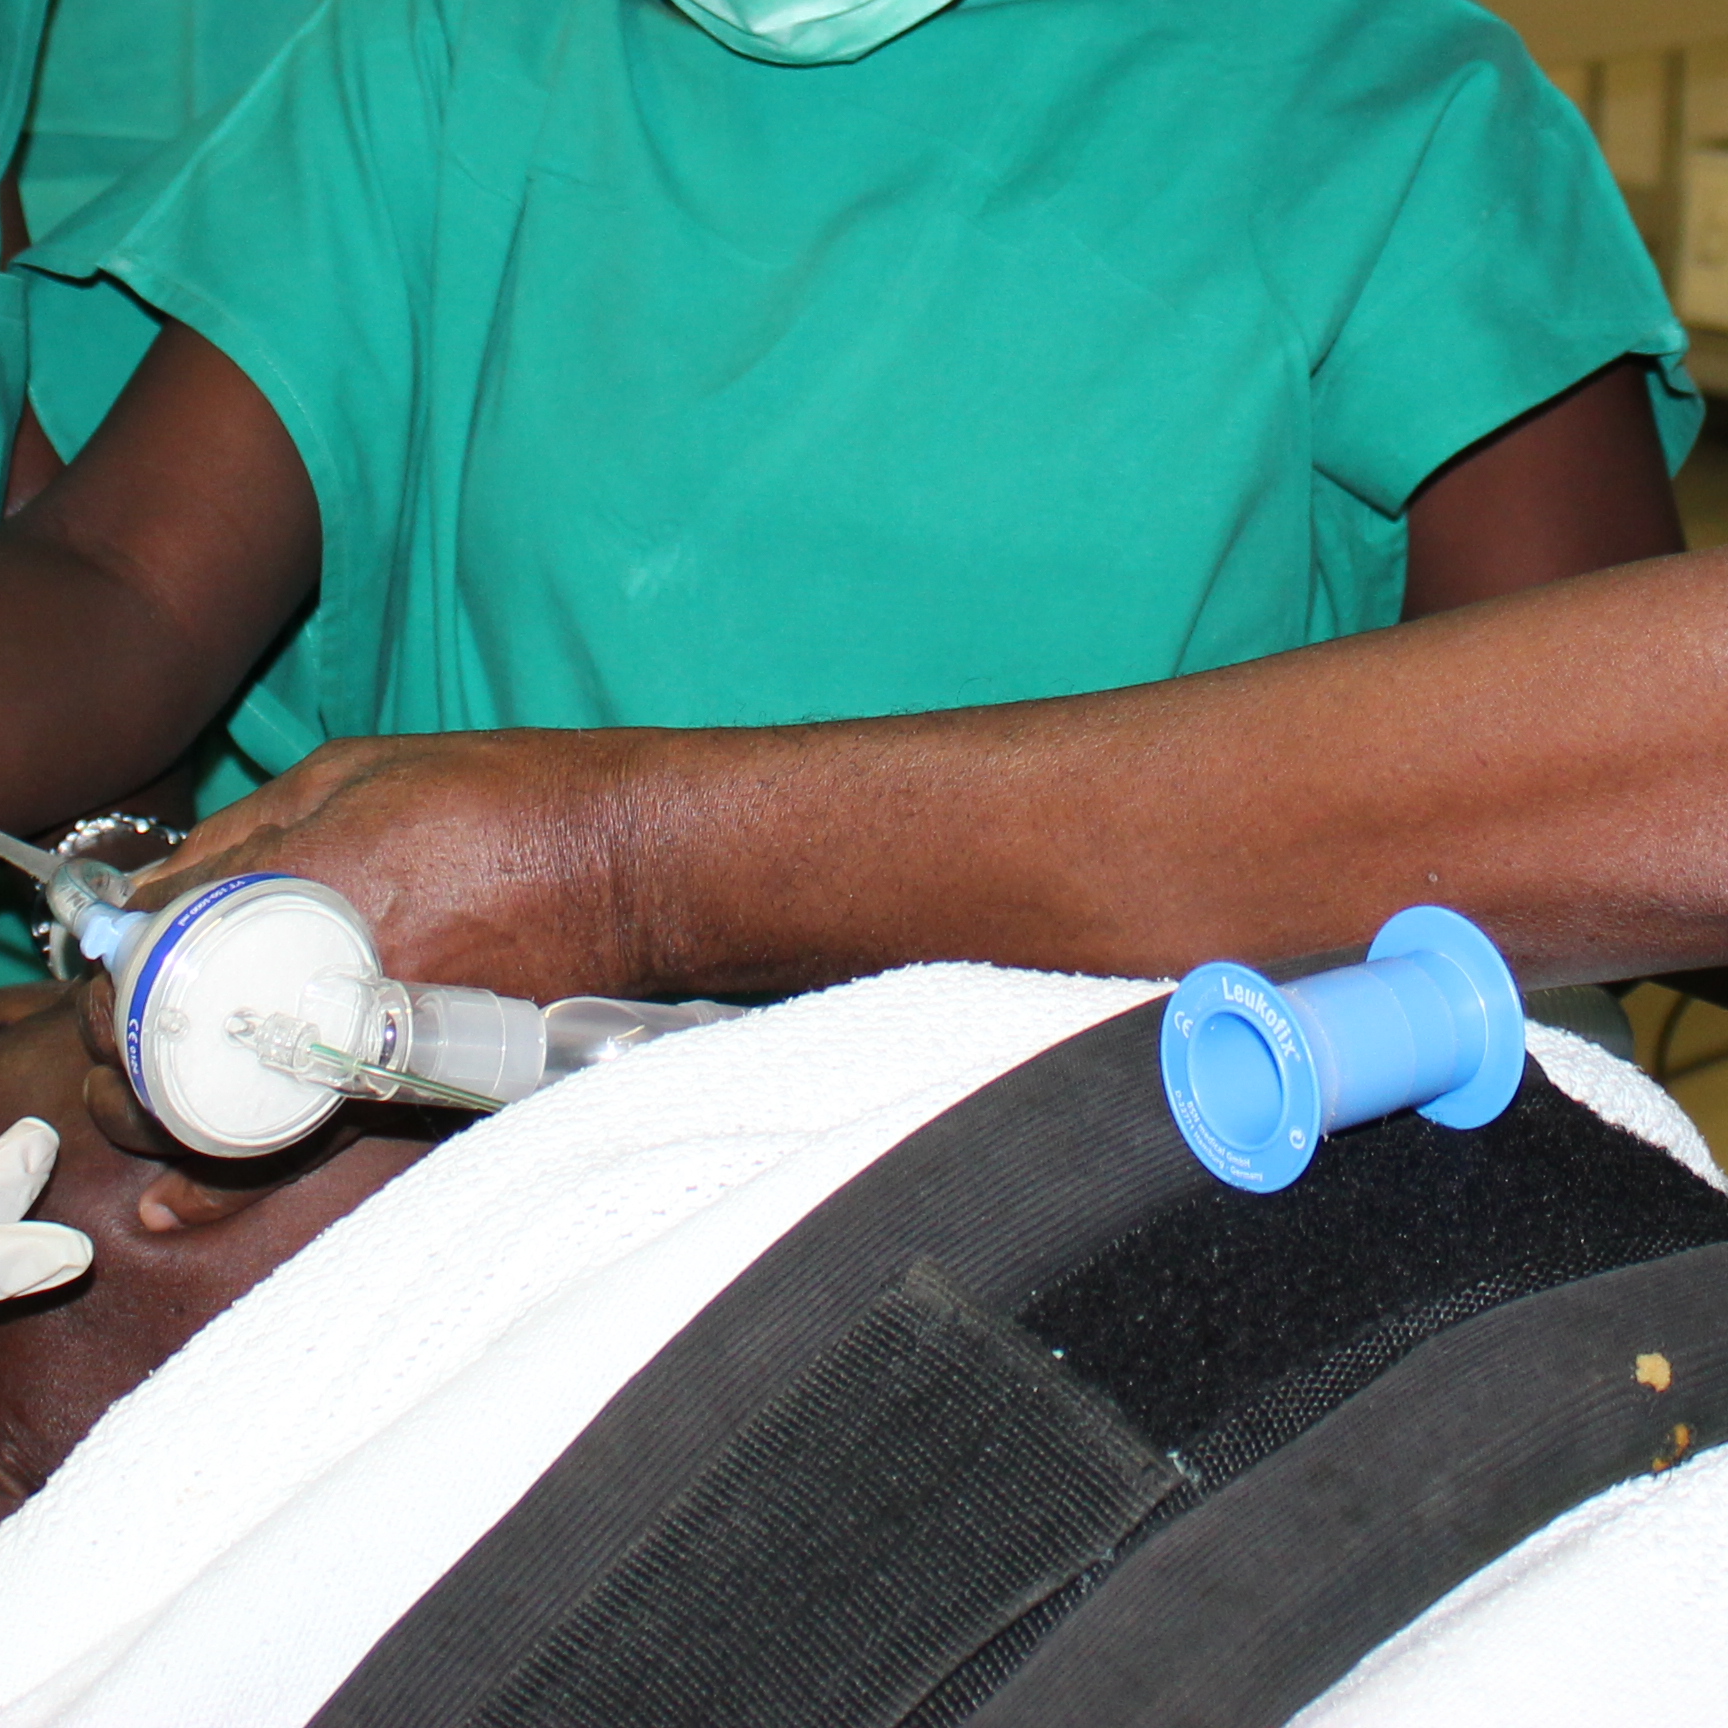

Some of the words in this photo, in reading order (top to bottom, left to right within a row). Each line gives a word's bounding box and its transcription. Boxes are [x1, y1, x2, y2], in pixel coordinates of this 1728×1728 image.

[177, 913, 190, 927] ml
[128, 1018, 139, 1044] CE
[1221, 976, 1297, 1058] Leukofix
[1186, 1100, 1200, 1123] BSN
[1197, 1123, 1226, 1156] medical
[1226, 1151, 1251, 1168] GmbH
[1193, 1130, 1225, 1170] Hamburg
[1230, 1165, 1263, 1182] Germany
